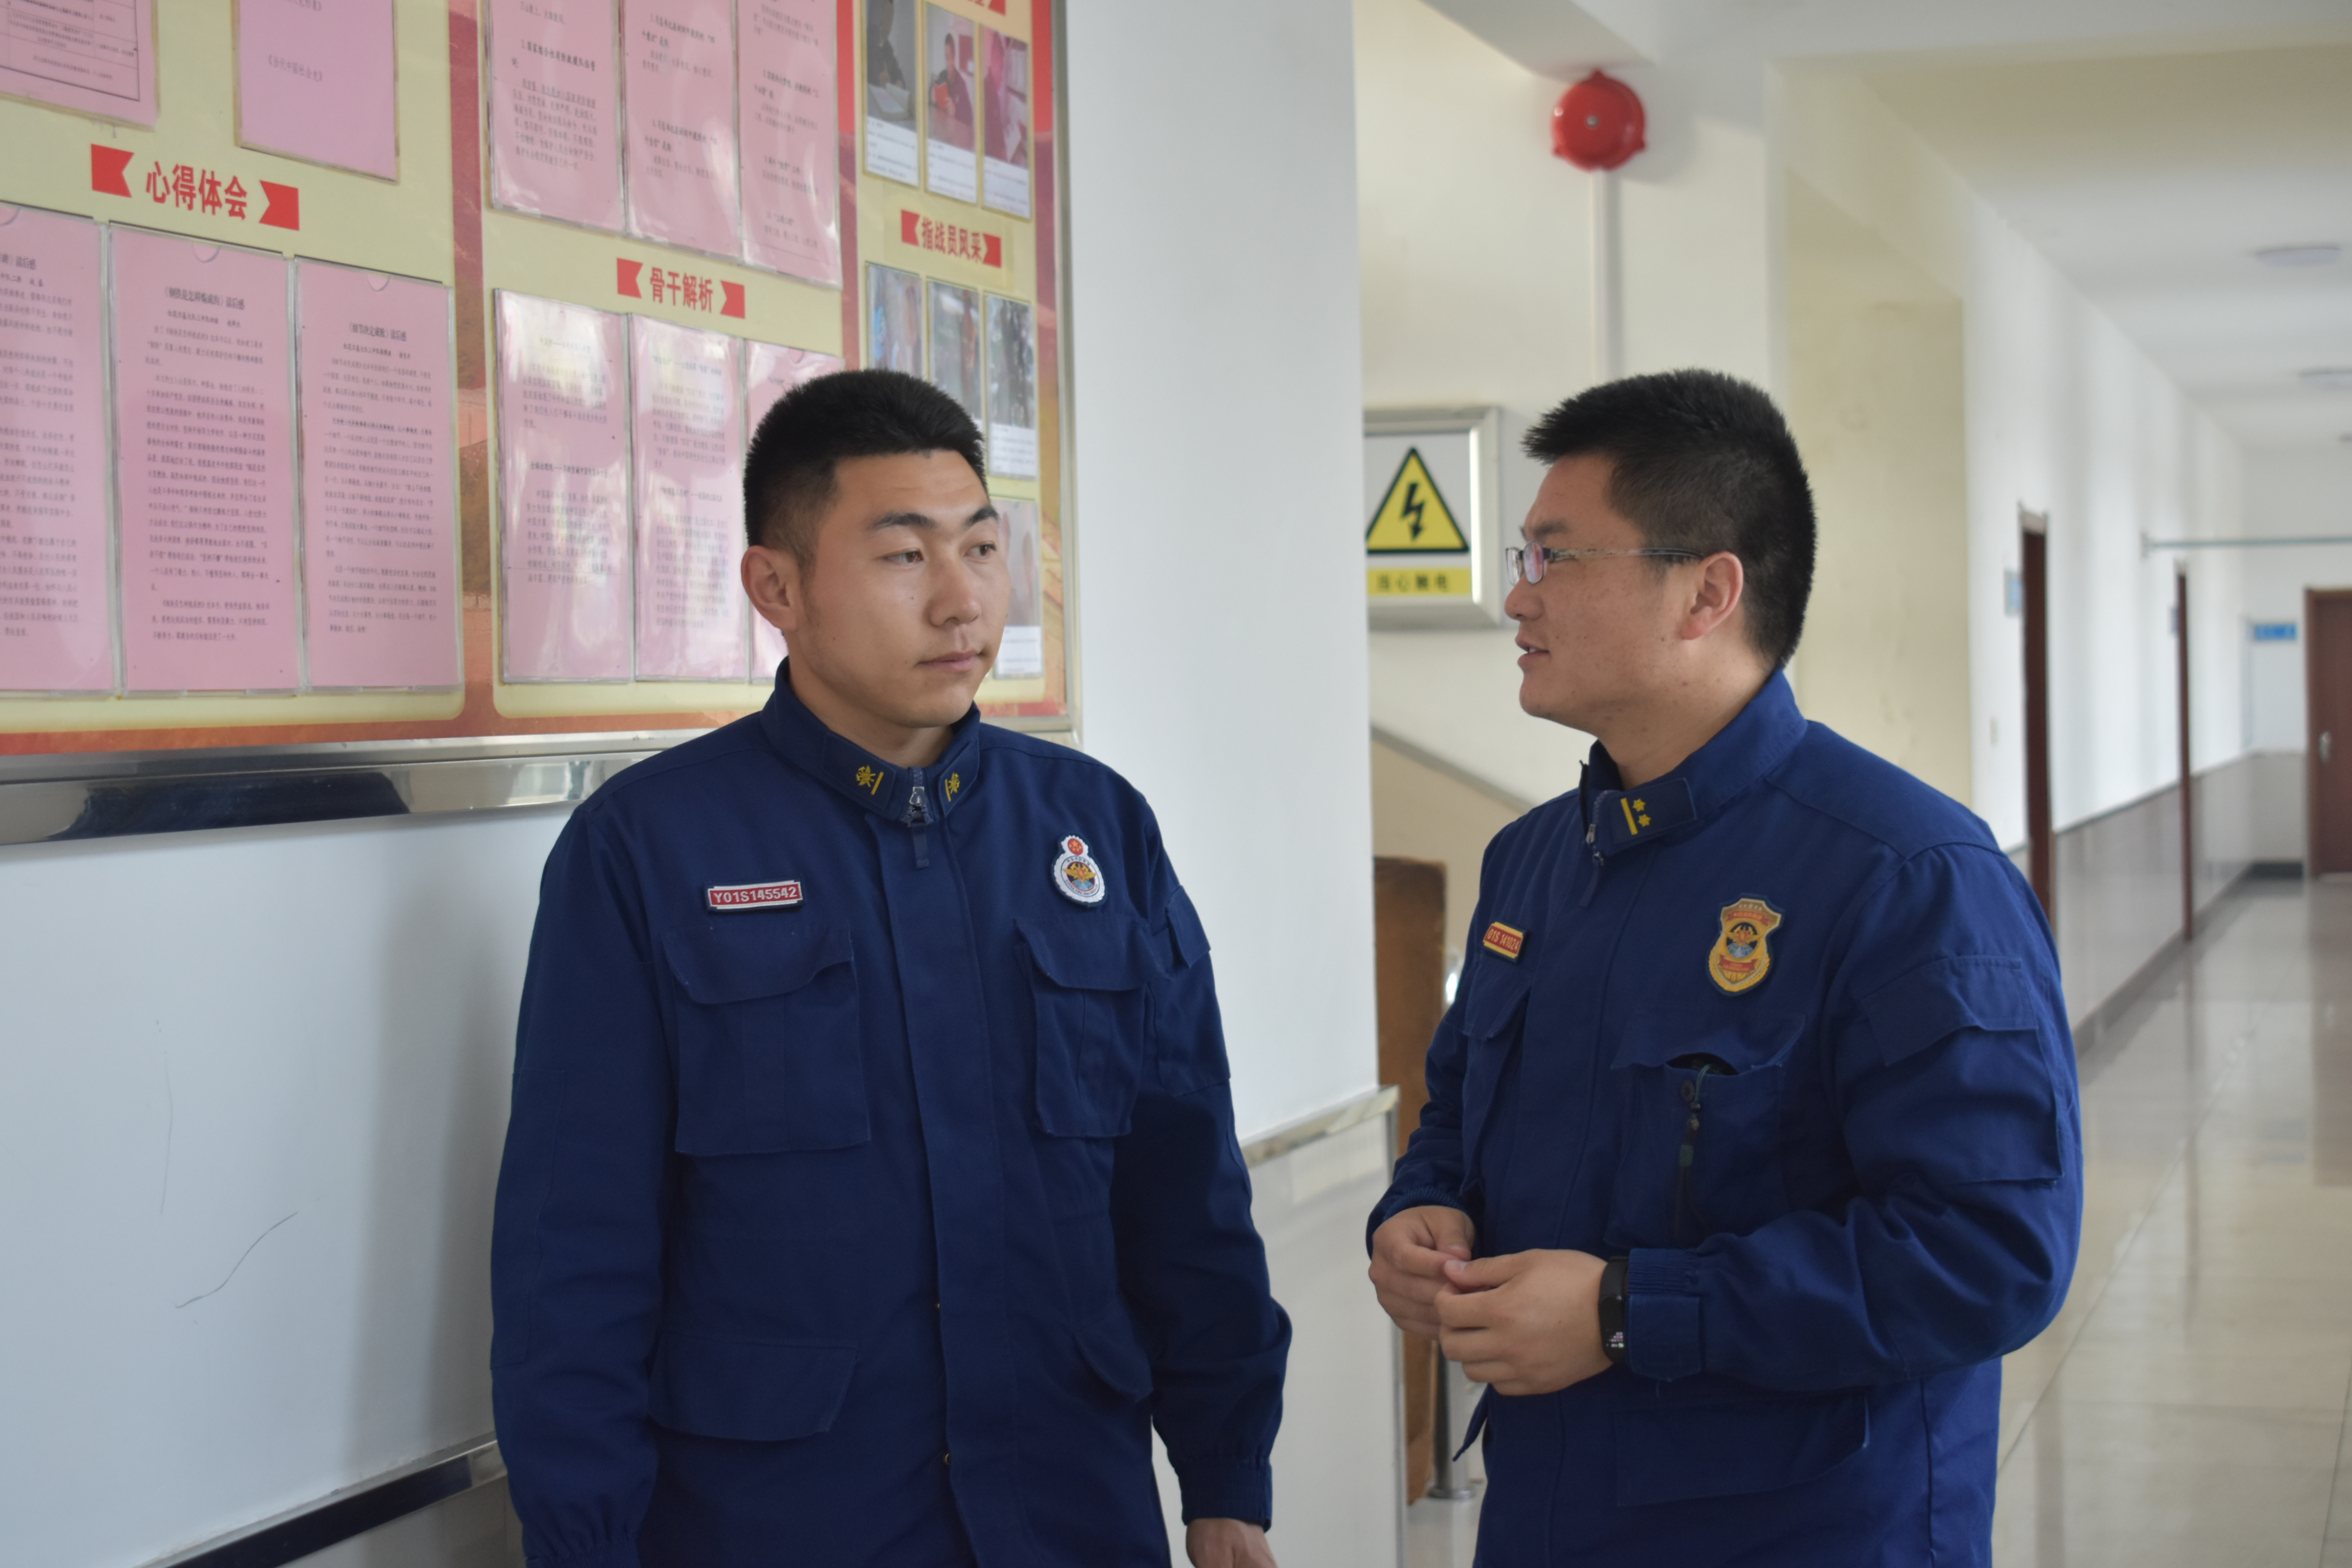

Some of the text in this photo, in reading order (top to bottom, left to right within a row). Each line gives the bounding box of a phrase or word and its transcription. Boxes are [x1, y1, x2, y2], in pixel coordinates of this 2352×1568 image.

[146, 160, 247, 221] 心得体会
[922, 216, 982, 263] 指战员风采
[650, 267, 713, 314] 骨干解析
[713, 886, 798, 904] Y01S145542
